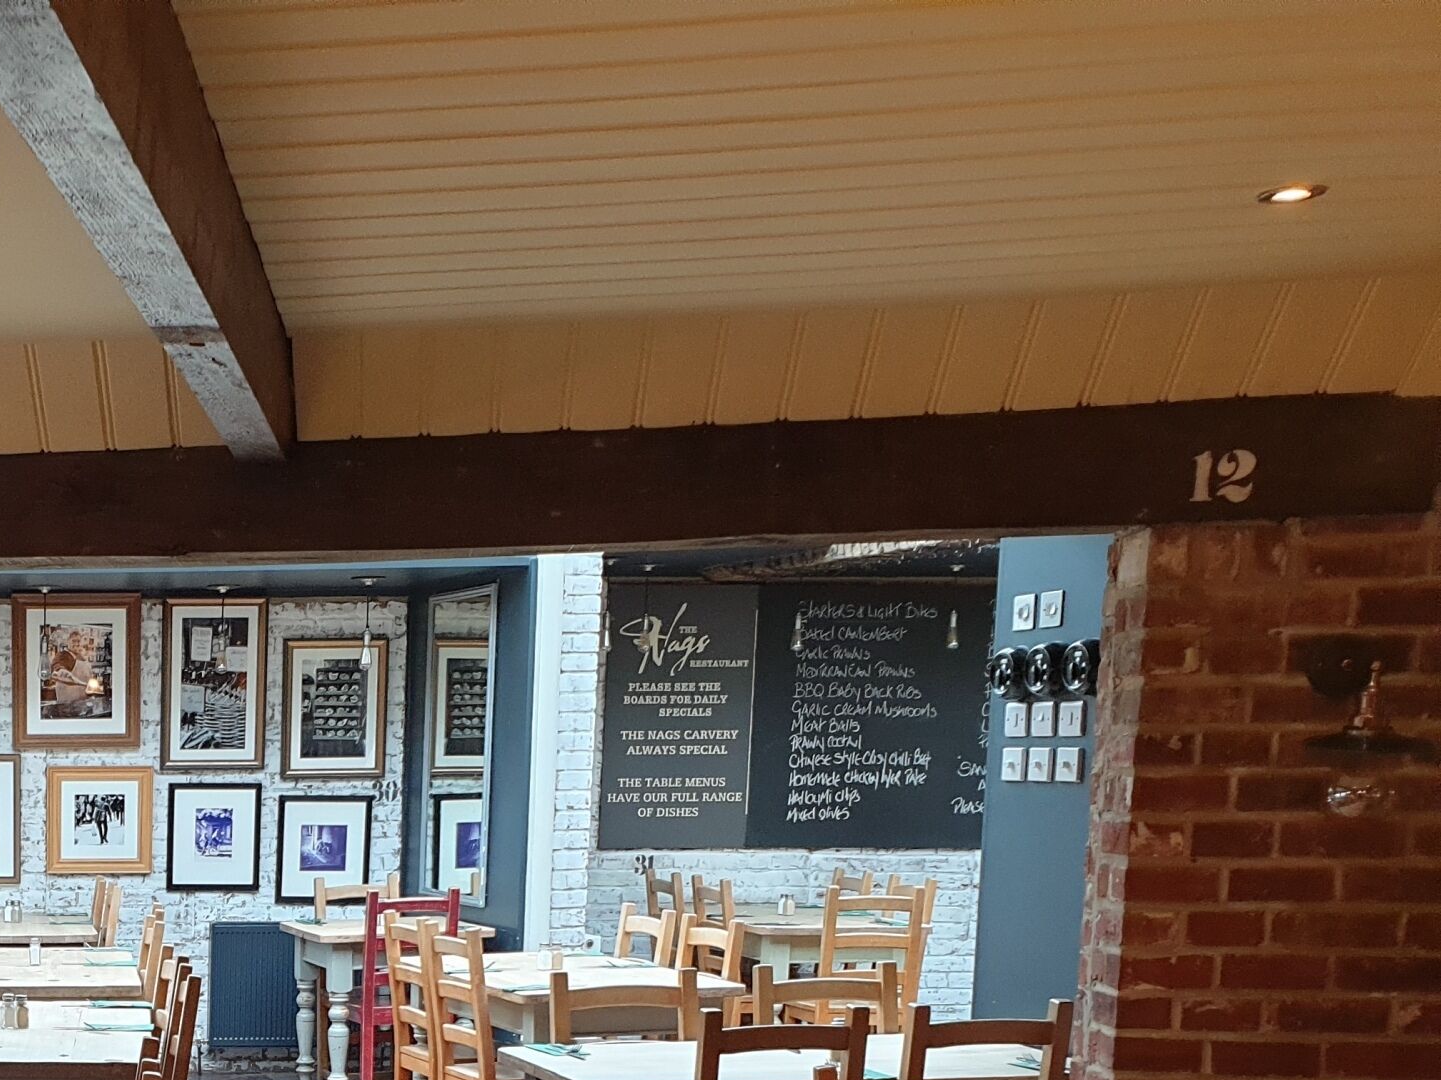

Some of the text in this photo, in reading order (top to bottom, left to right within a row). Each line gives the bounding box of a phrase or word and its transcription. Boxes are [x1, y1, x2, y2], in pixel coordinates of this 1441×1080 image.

[1189, 449, 1257, 503] 12
[679, 625, 698, 634] THE
[620, 602, 710, 676] Nags
[689, 659, 750, 668] RESTAURANT
[628, 682, 721, 692] PLEASE SEE THE
[792, 682, 825, 699] BBQ
[623, 695, 728, 704] BOARDS FOR DAILY
[659, 707, 712, 717] SPECIALS
[791, 700, 831, 718] GARLIC
[620, 729, 739, 740] THE NAGS CARVERY
[626, 745, 728, 755] ALWAYS SPECIAL
[617, 777, 726, 787] THE TABLE MENUS
[372, 780, 398, 802] 30
[607, 791, 743, 803] HAVE OUR FULL RANGE
[637, 807, 699, 817] OF DISHES
[634, 854, 655, 876] 31
